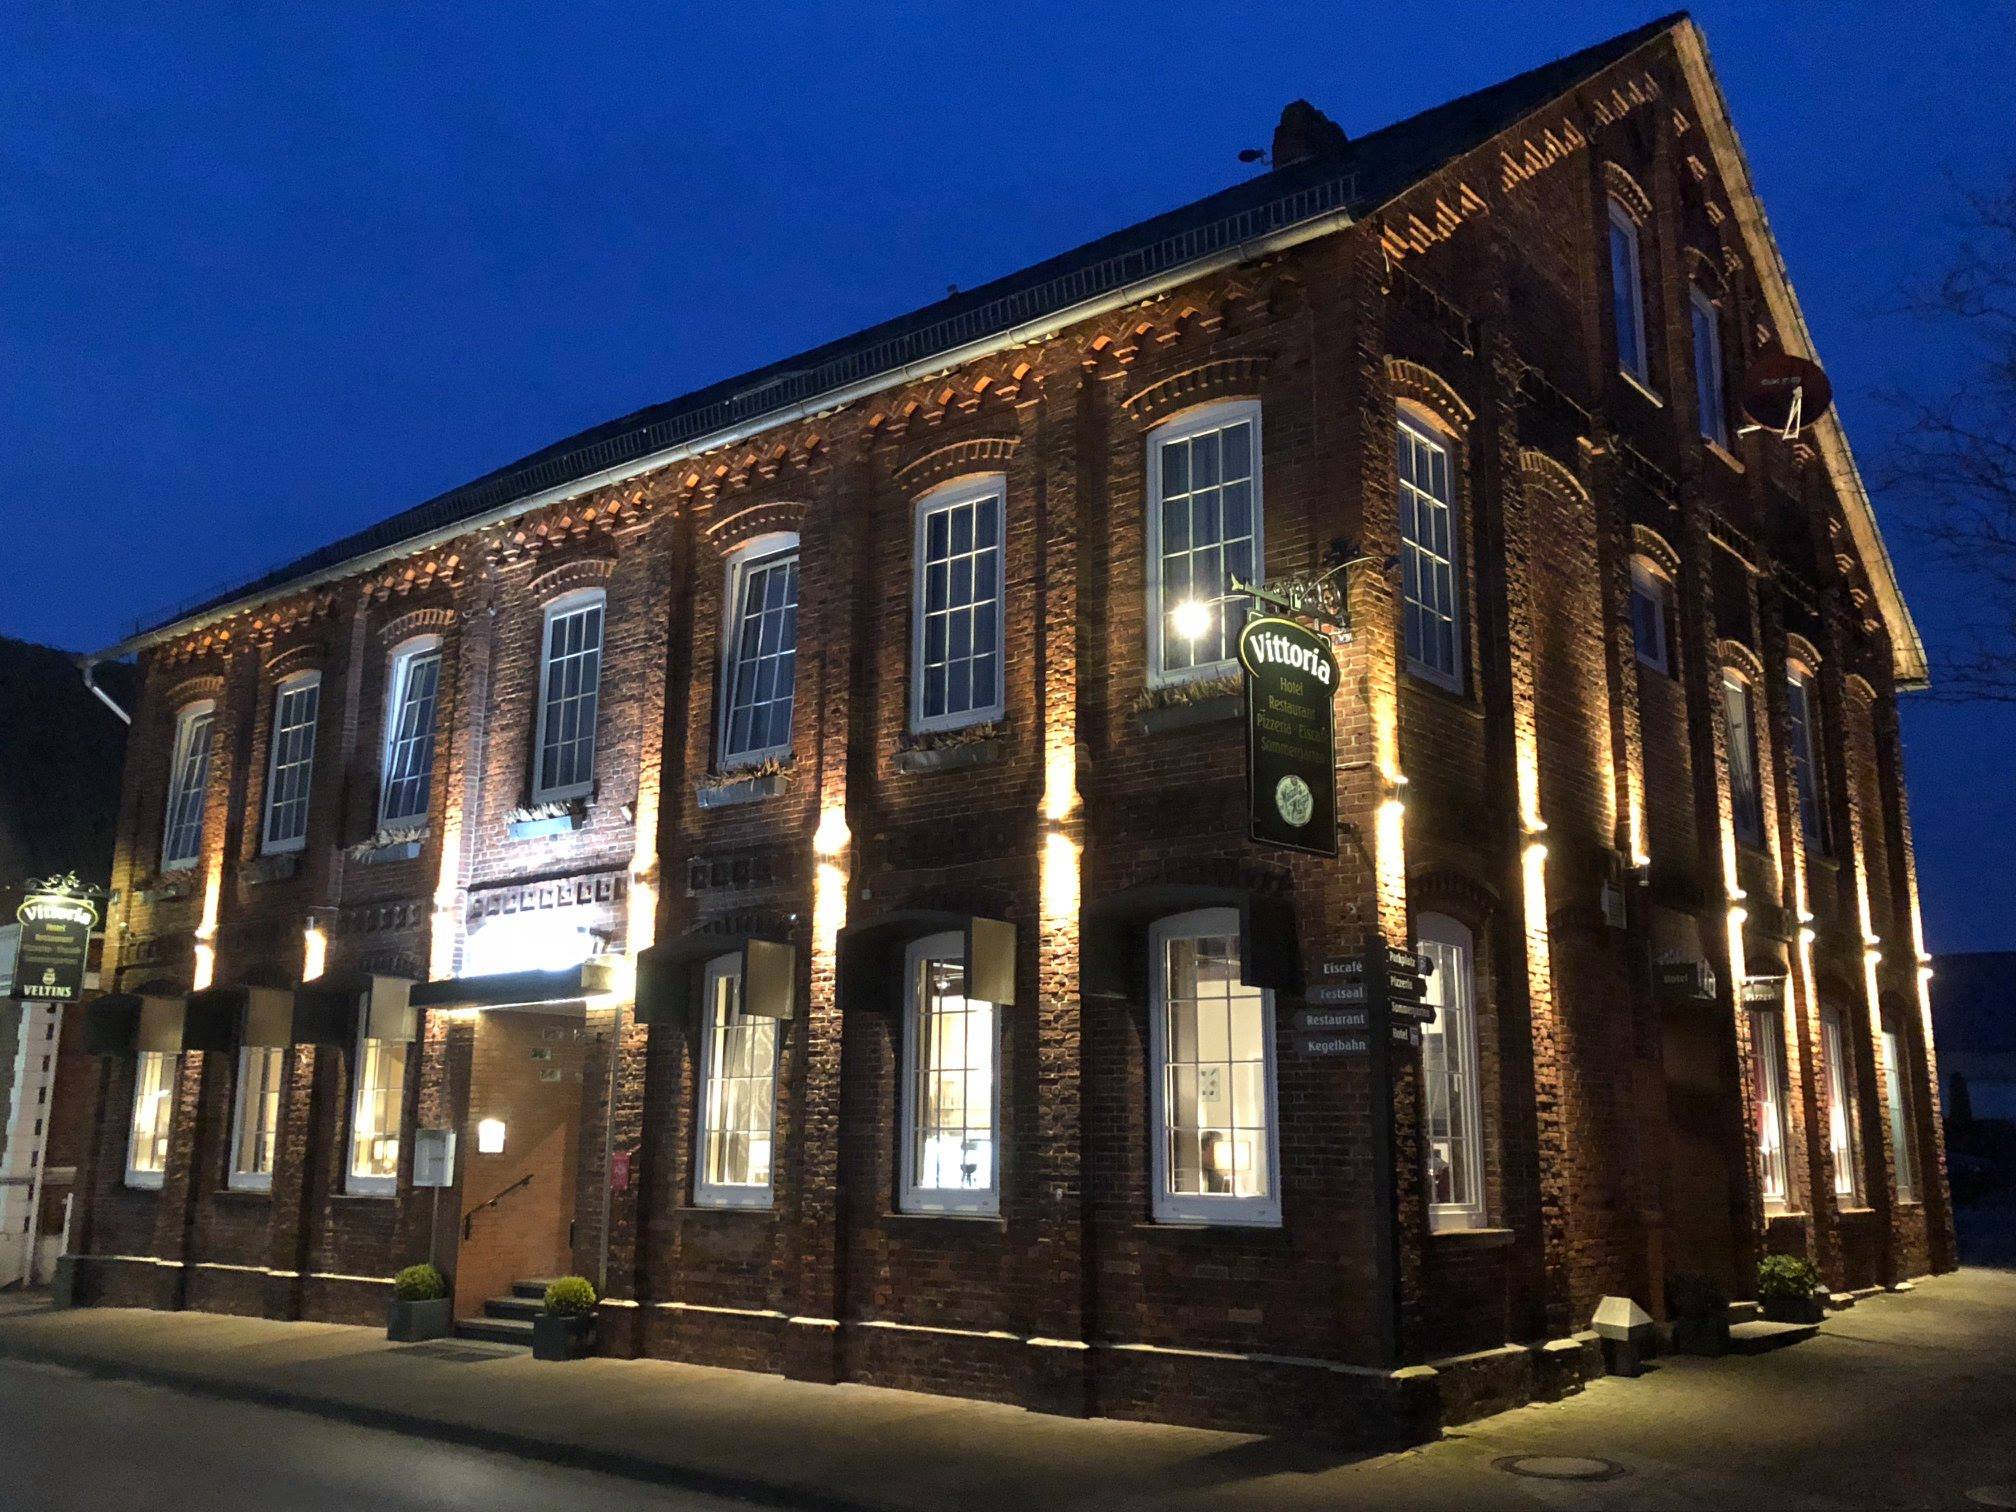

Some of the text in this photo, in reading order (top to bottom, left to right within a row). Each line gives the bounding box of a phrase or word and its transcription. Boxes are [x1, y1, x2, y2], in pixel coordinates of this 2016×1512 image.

[1250, 632, 1331, 684] Vittoria
[1280, 677, 1303, 696] Hotel
[1268, 695, 1316, 720] Restaurant
[1323, 961, 1363, 974] Eiscafé
[23, 984, 72, 998] VELTINS
[1306, 1013, 1365, 1026] Restaurant
[1308, 1039, 1366, 1054] Kegelbahn
